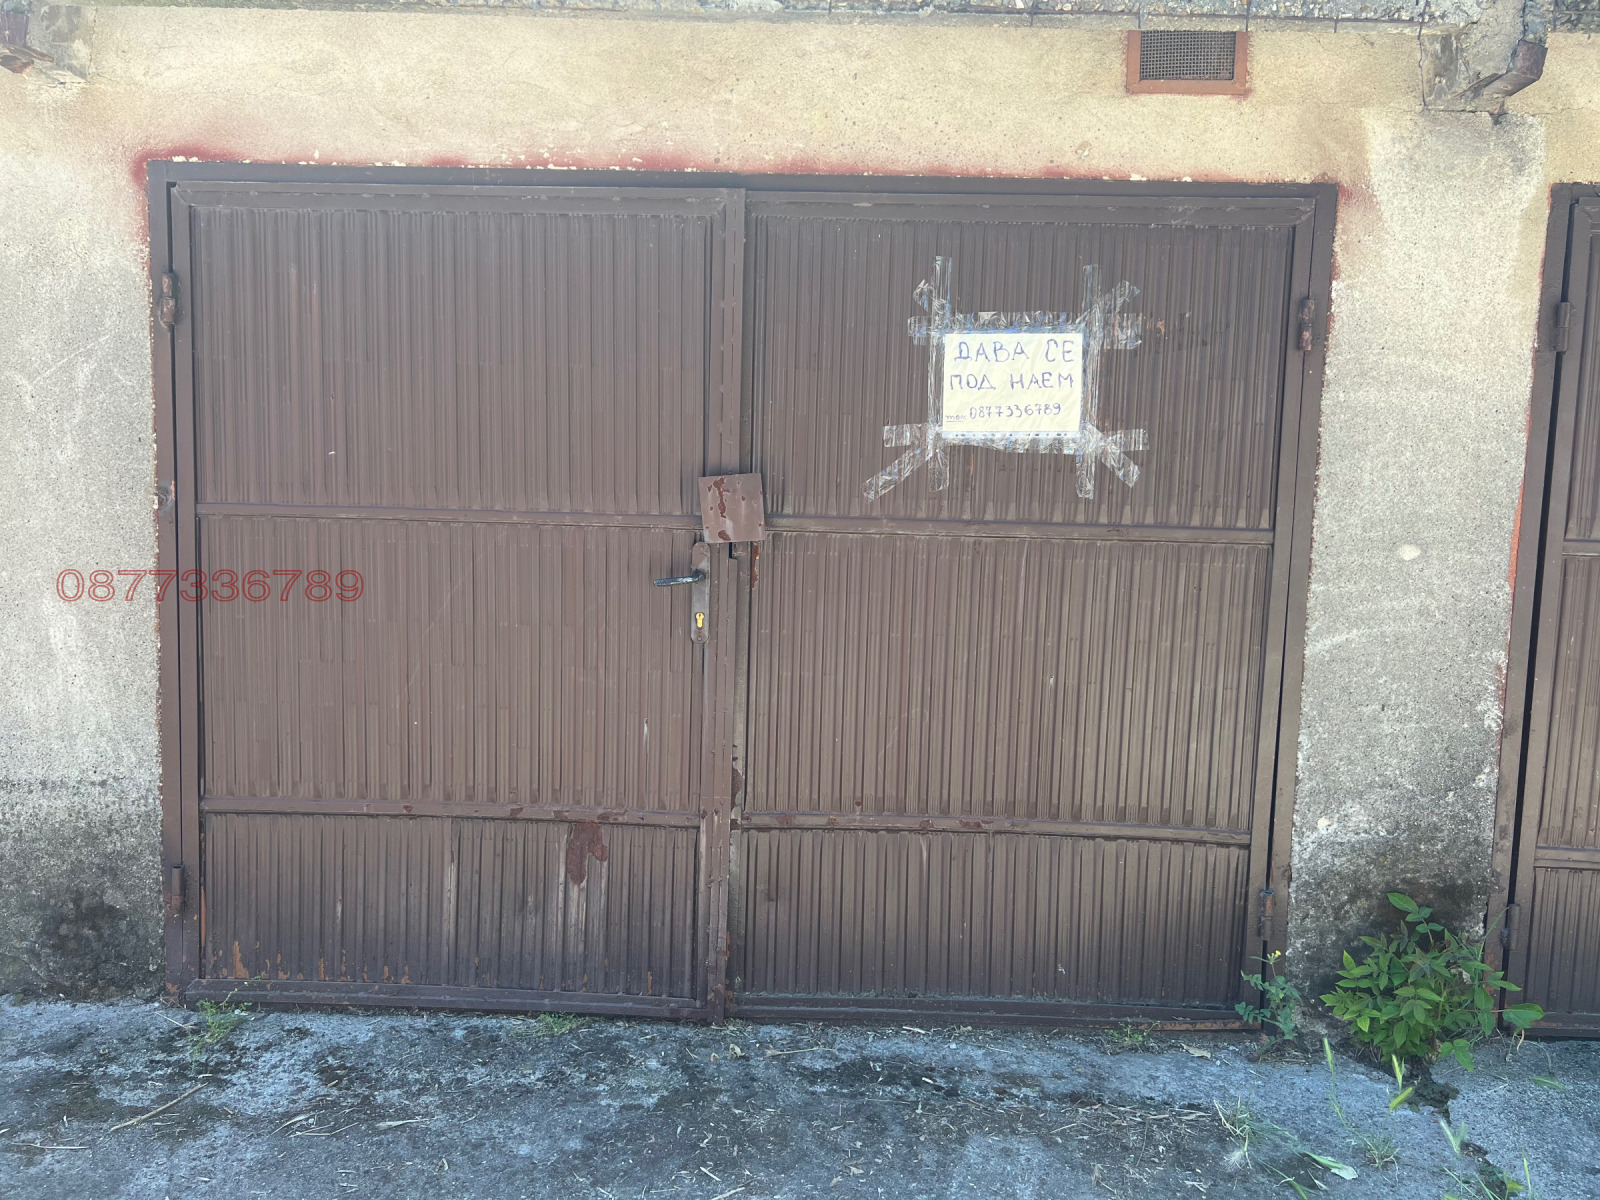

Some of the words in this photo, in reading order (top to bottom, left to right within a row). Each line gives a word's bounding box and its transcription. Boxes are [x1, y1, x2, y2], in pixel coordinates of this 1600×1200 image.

[954, 340, 1030, 363] ДАВА
[1044, 338, 1075, 363] СЕ
[949, 373, 997, 390] ПОД
[1009, 371, 1074, 390] НАЕМ
[969, 402, 1062, 420] 0877336789
